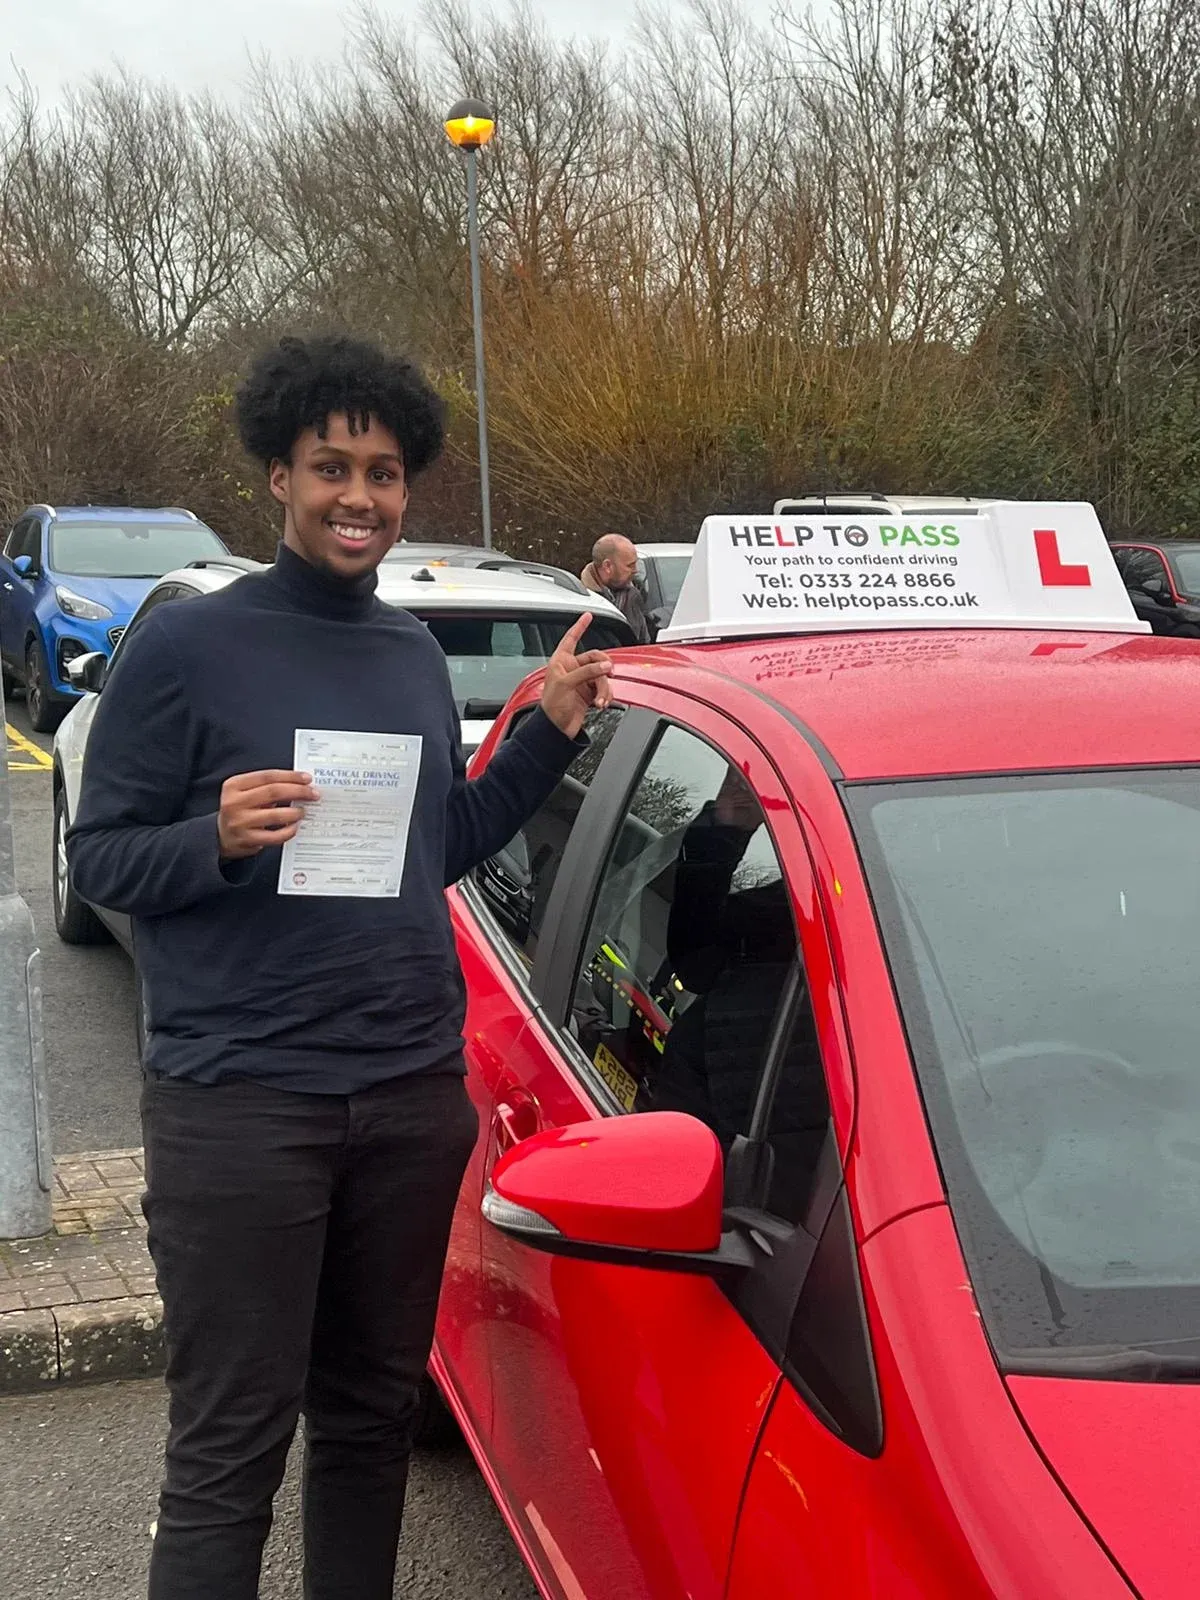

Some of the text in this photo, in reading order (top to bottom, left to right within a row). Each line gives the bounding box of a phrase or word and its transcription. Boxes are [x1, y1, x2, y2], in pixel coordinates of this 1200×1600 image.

[729, 525, 814, 547] HELP
[879, 525, 960, 547] PASS
[744, 553, 958, 567] Your path to confident driving
[1033, 529, 1091, 586] L
[755, 572, 956, 588] Tel: 0333 224 8866
[742, 591, 979, 611] Web: helptopass.co.uk
[313, 768, 400, 780] PRACTICAL DRIVING
[314, 777, 400, 788] TEST PASS CERTIFICATE
